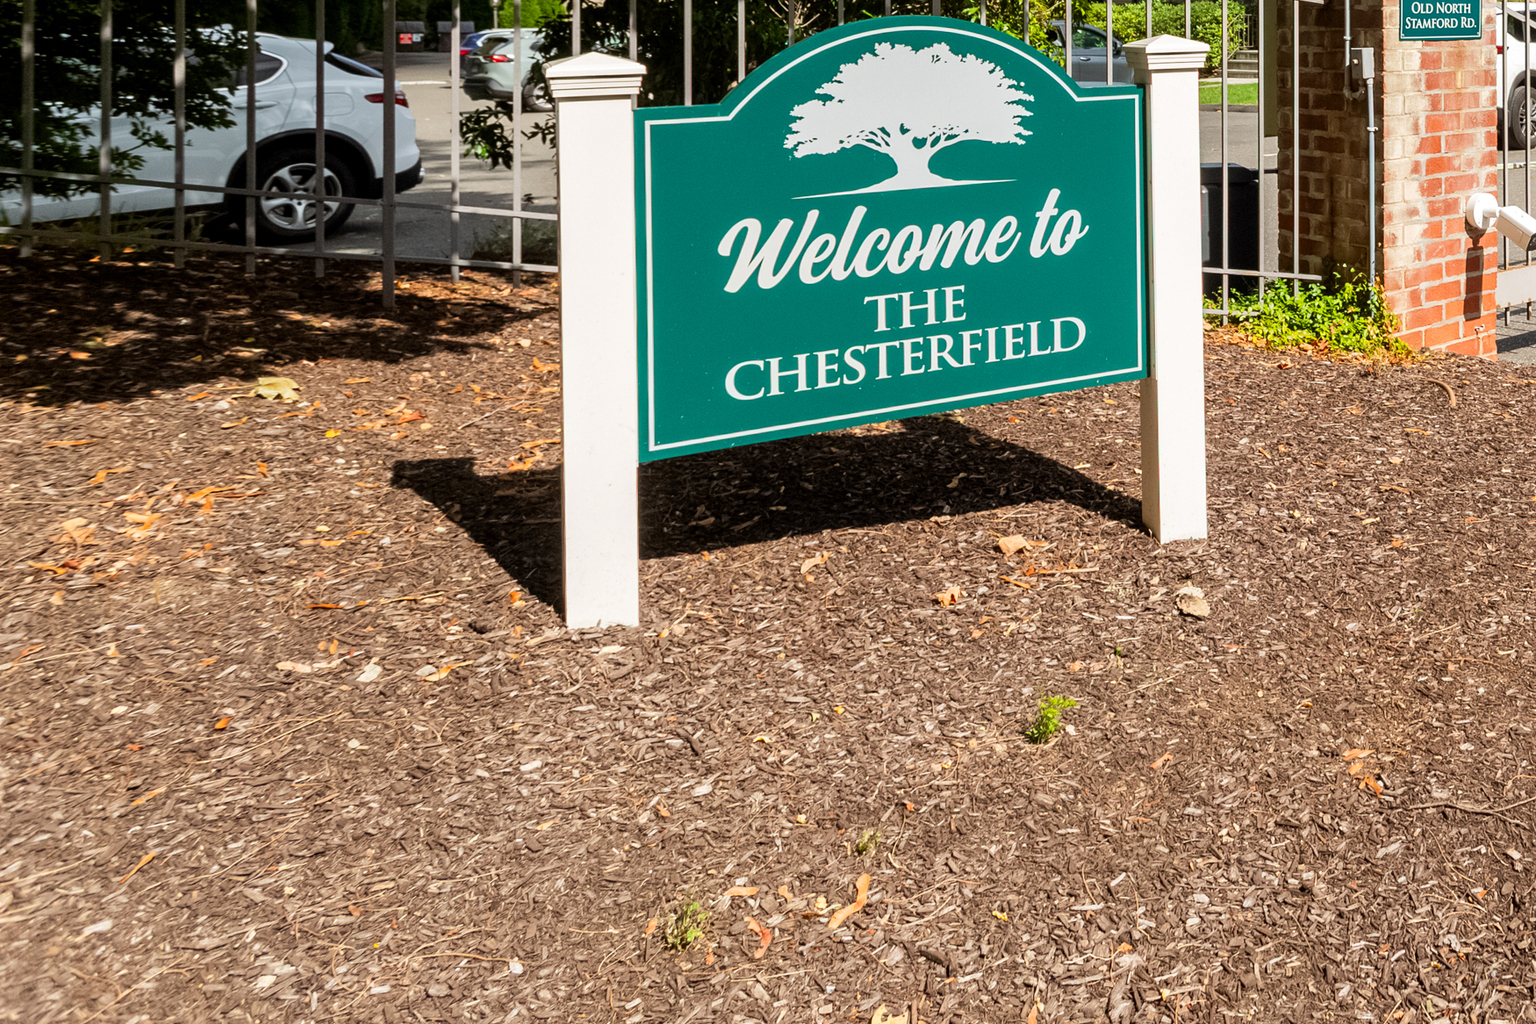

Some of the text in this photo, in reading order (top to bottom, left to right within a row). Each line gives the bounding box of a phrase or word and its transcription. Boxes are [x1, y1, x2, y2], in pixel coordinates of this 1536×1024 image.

[1405, 16, 1477, 29] STAMFORD RD.
[1411, 1, 1471, 14] OLD NORTH
[717, 188, 1089, 293] Welcome to
[863, 285, 967, 333] THE
[724, 316, 1087, 401] CHESTERFIELD
